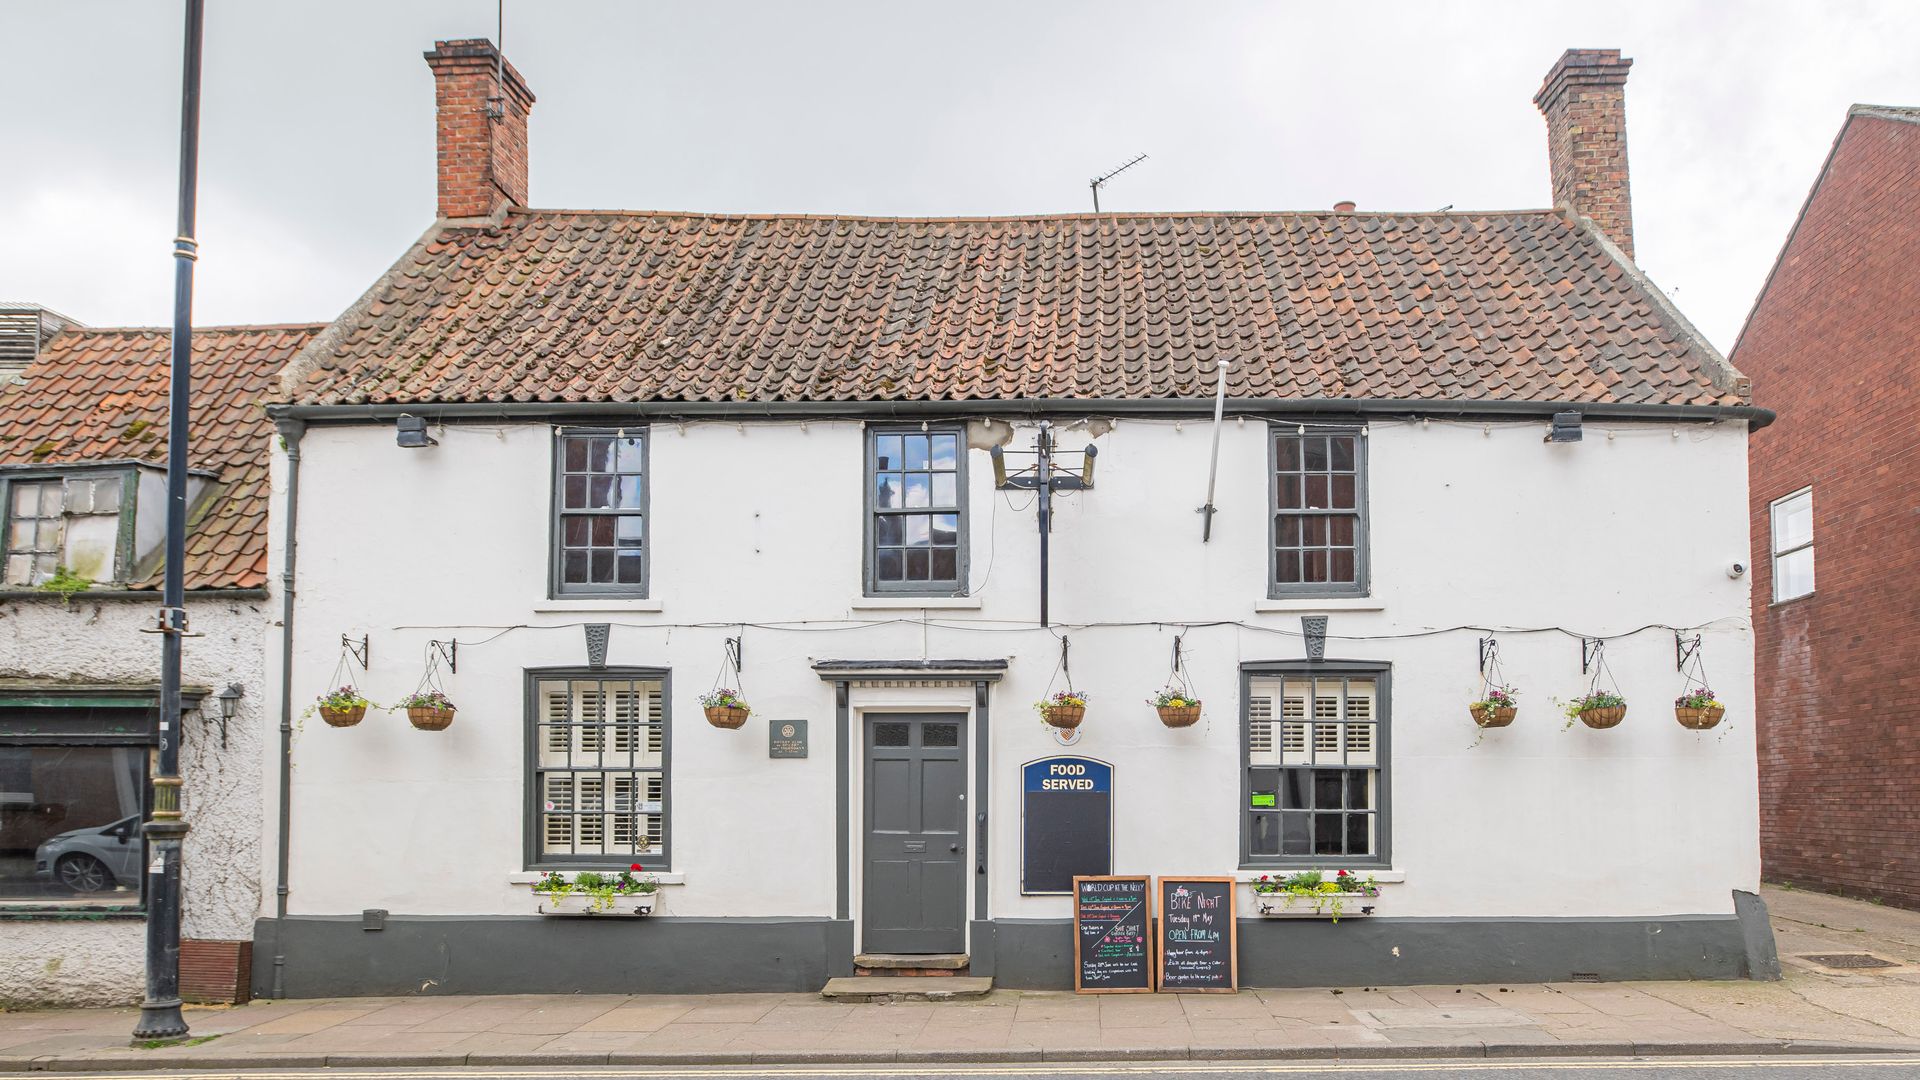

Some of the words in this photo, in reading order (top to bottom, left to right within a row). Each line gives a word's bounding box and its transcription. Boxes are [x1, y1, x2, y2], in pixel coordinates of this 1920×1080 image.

[1050, 765, 1086, 775] FOOD
[1042, 779, 1094, 790] SERVED
[1080, 883, 1102, 892] WORLD
[1103, 883, 1114, 892] CUP
[1170, 892, 1193, 909] BIKE
[1197, 892, 1222, 909] NIGHT
[1168, 913, 1190, 931] Tuesday
[1202, 912, 1213, 925] May
[1168, 929, 1187, 940] OPEN
[1190, 929, 1206, 940] FROM
